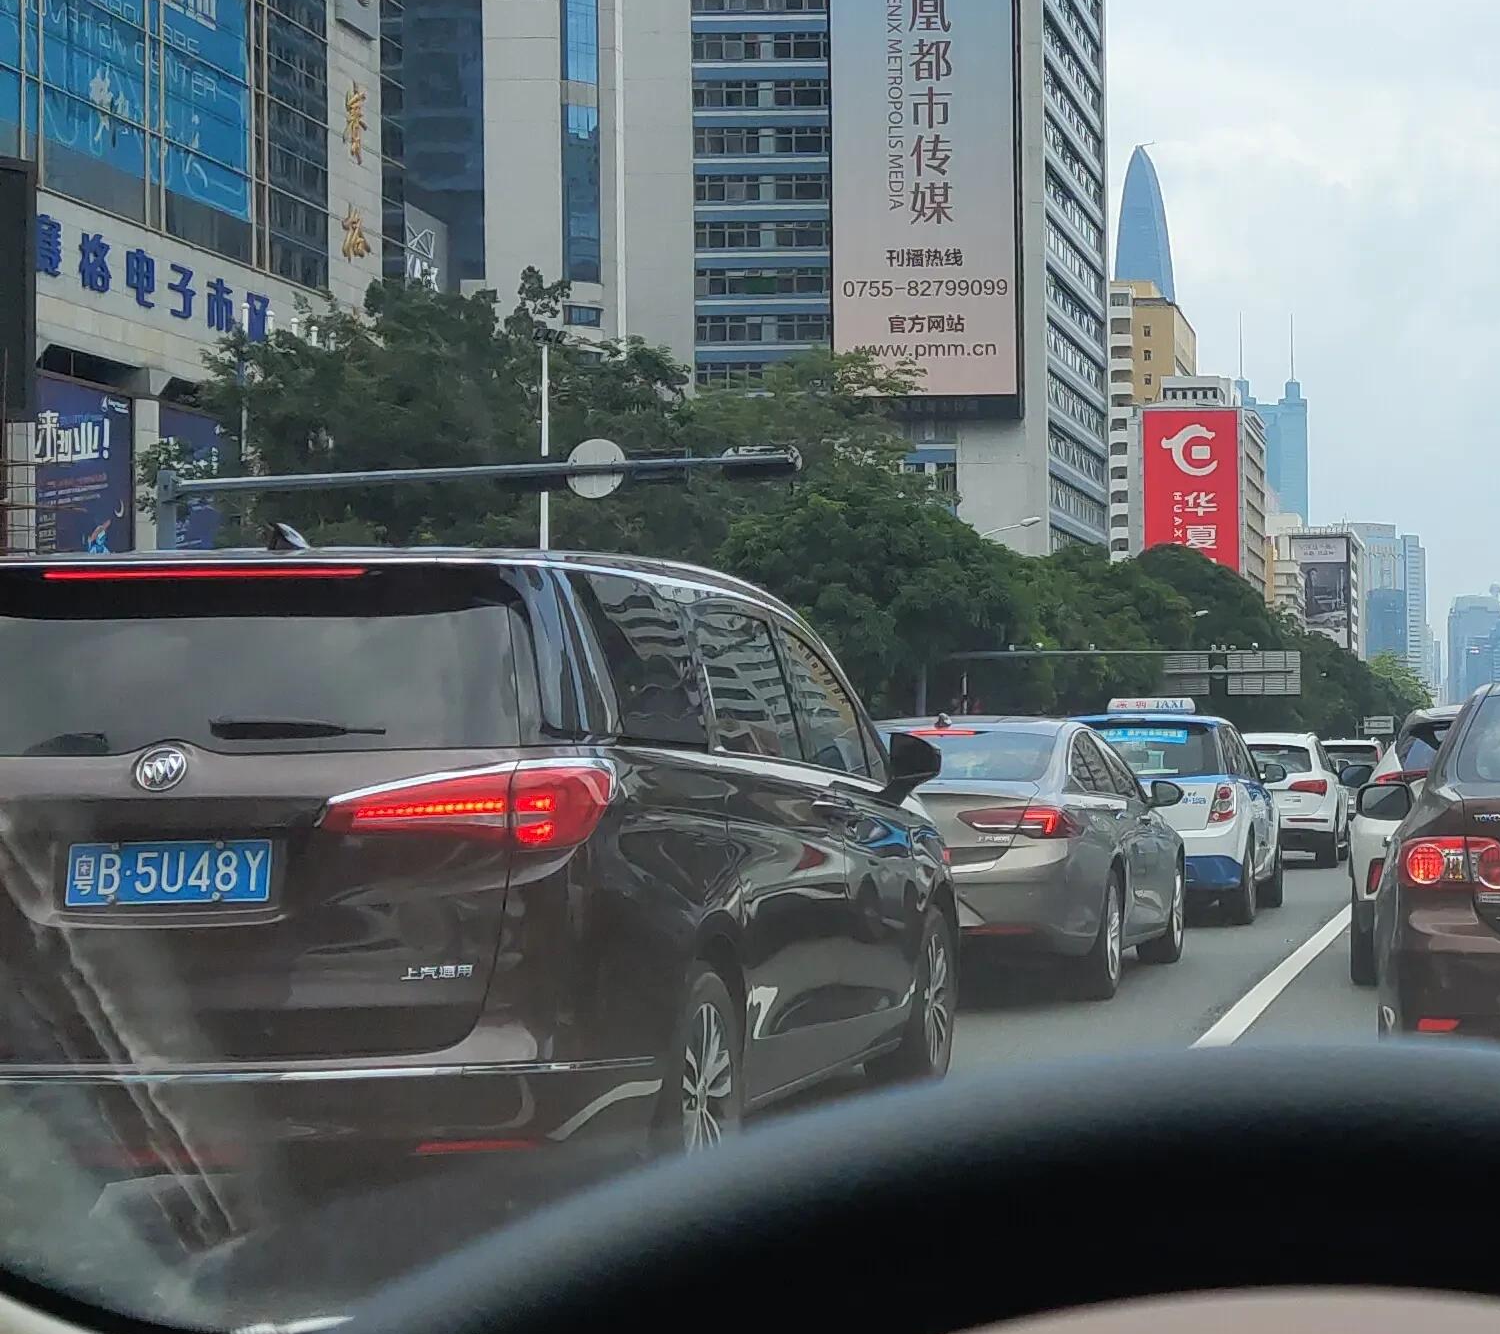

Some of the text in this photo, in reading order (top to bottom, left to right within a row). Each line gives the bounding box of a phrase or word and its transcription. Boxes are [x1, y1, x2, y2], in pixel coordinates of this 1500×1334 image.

[887, 39, 905, 150] METROPOLIS
[888, 154, 905, 211] MEDIA
[886, 248, 964, 267] 刊播热线
[843, 279, 1008, 298] 0755-82799099
[888, 314, 965, 334] 官方网站
[855, 343, 997, 360] www.pmm.cn
[1184, 492, 1218, 563] 华夏
[1155, 700, 1185, 709] TAXI
[401, 965, 473, 981] 上汽通用
